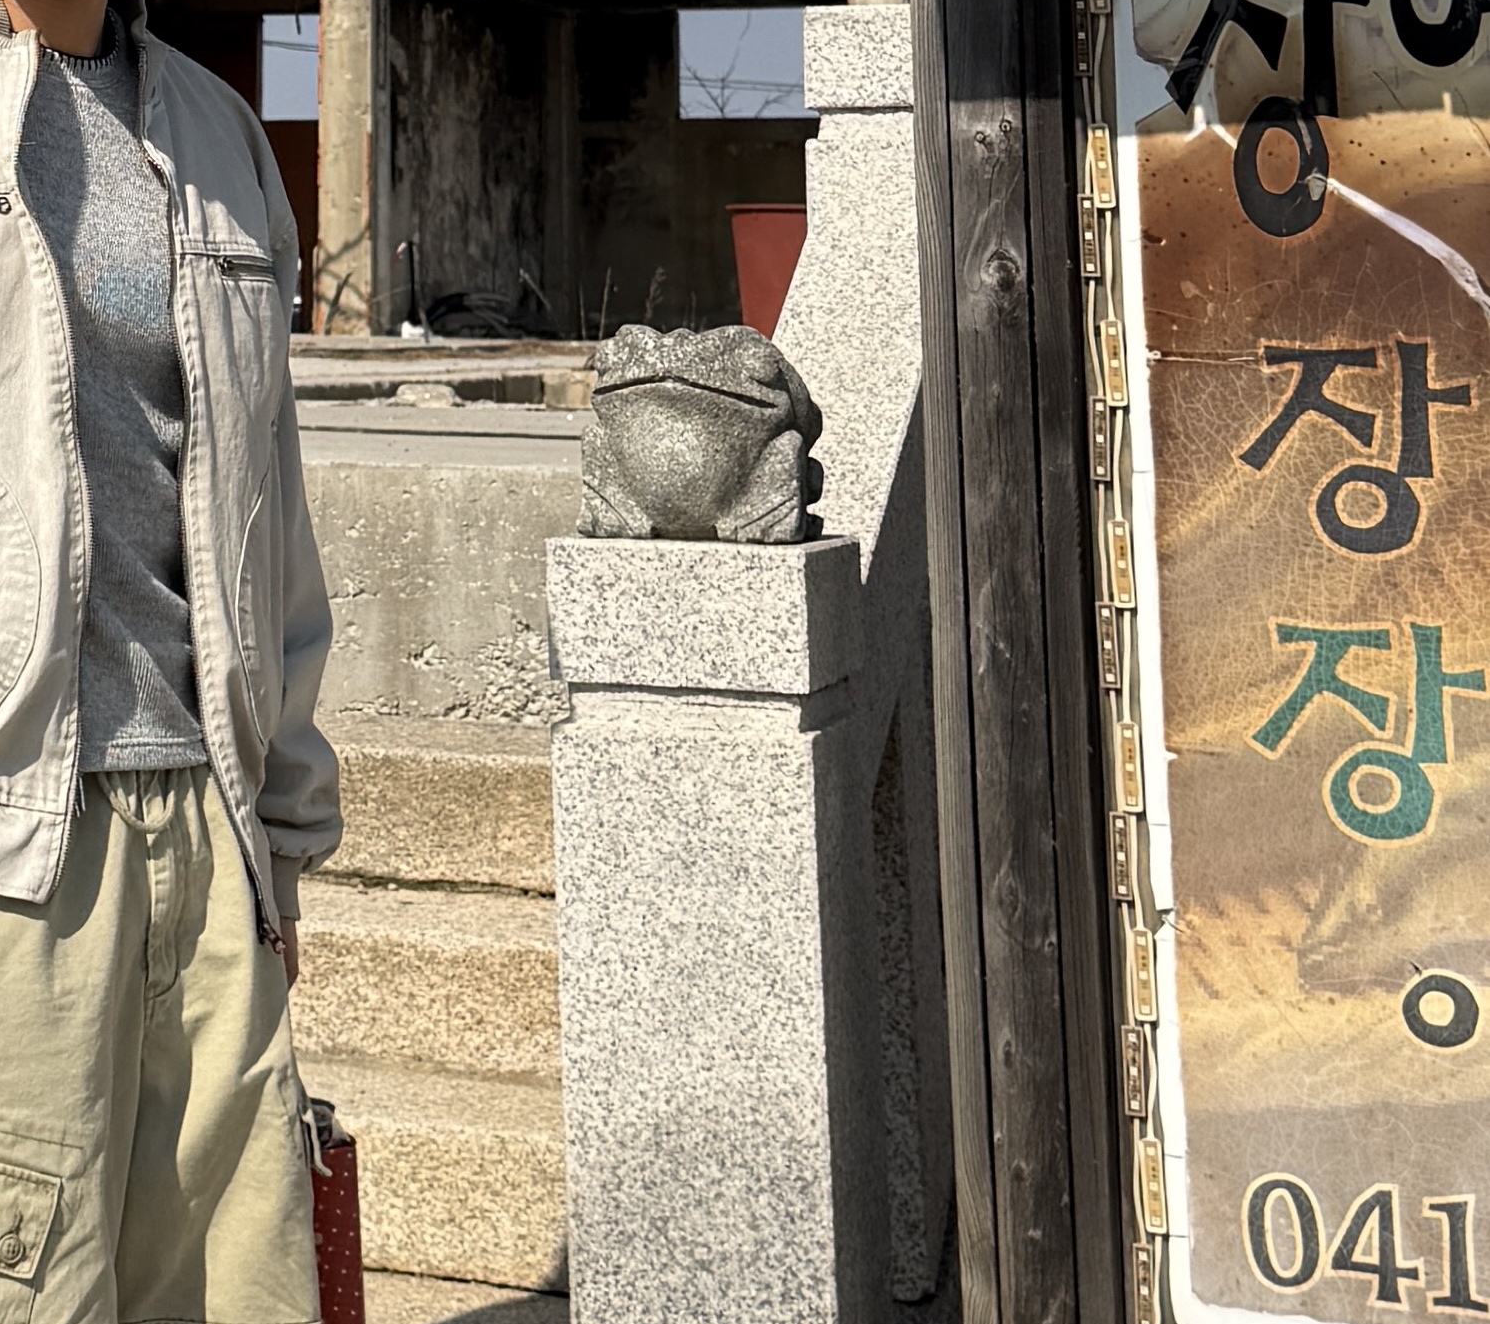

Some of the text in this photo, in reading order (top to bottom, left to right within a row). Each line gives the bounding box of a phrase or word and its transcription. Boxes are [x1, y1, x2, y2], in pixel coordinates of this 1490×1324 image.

[1237, 339, 1472, 555] 장
[1251, 622, 1486, 841] 장
[1246, 1178, 1490, 1313] 041
